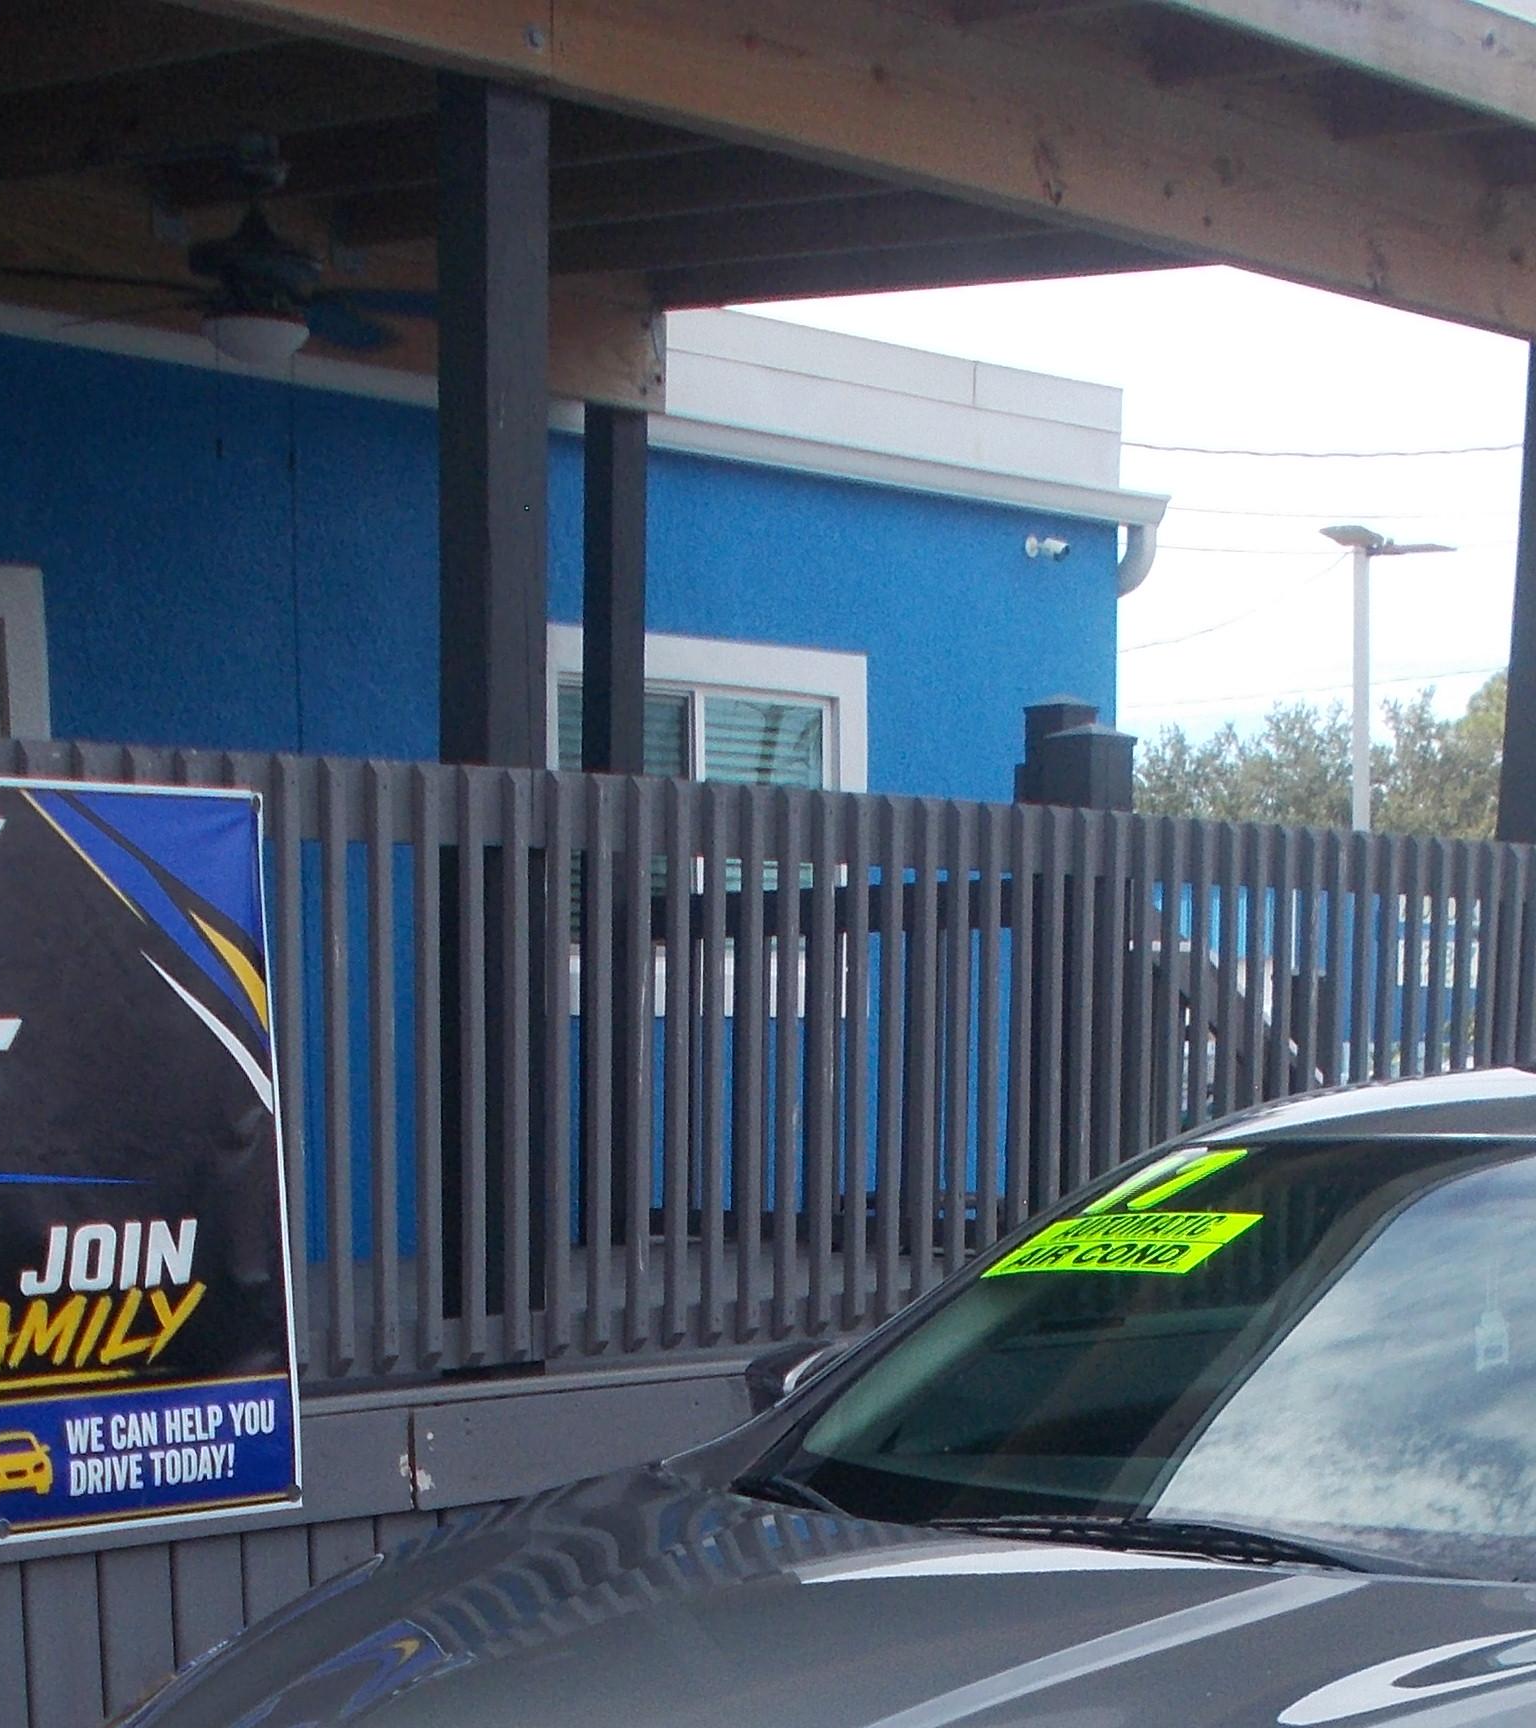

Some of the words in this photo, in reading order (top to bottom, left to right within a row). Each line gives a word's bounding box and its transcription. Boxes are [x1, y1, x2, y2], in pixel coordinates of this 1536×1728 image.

[1056, 1214, 1228, 1240] AUTOMATIC
[19, 1218, 199, 1298] JOIN
[1013, 1243, 1080, 1269] AIR
[65, 1415, 104, 1455] WE
[110, 1410, 158, 1452] CAN
[164, 1404, 224, 1446] HELP
[229, 1399, 276, 1437] YOU
[68, 1453, 144, 1498] DRIVE
[150, 1443, 236, 1487] TODAY!
